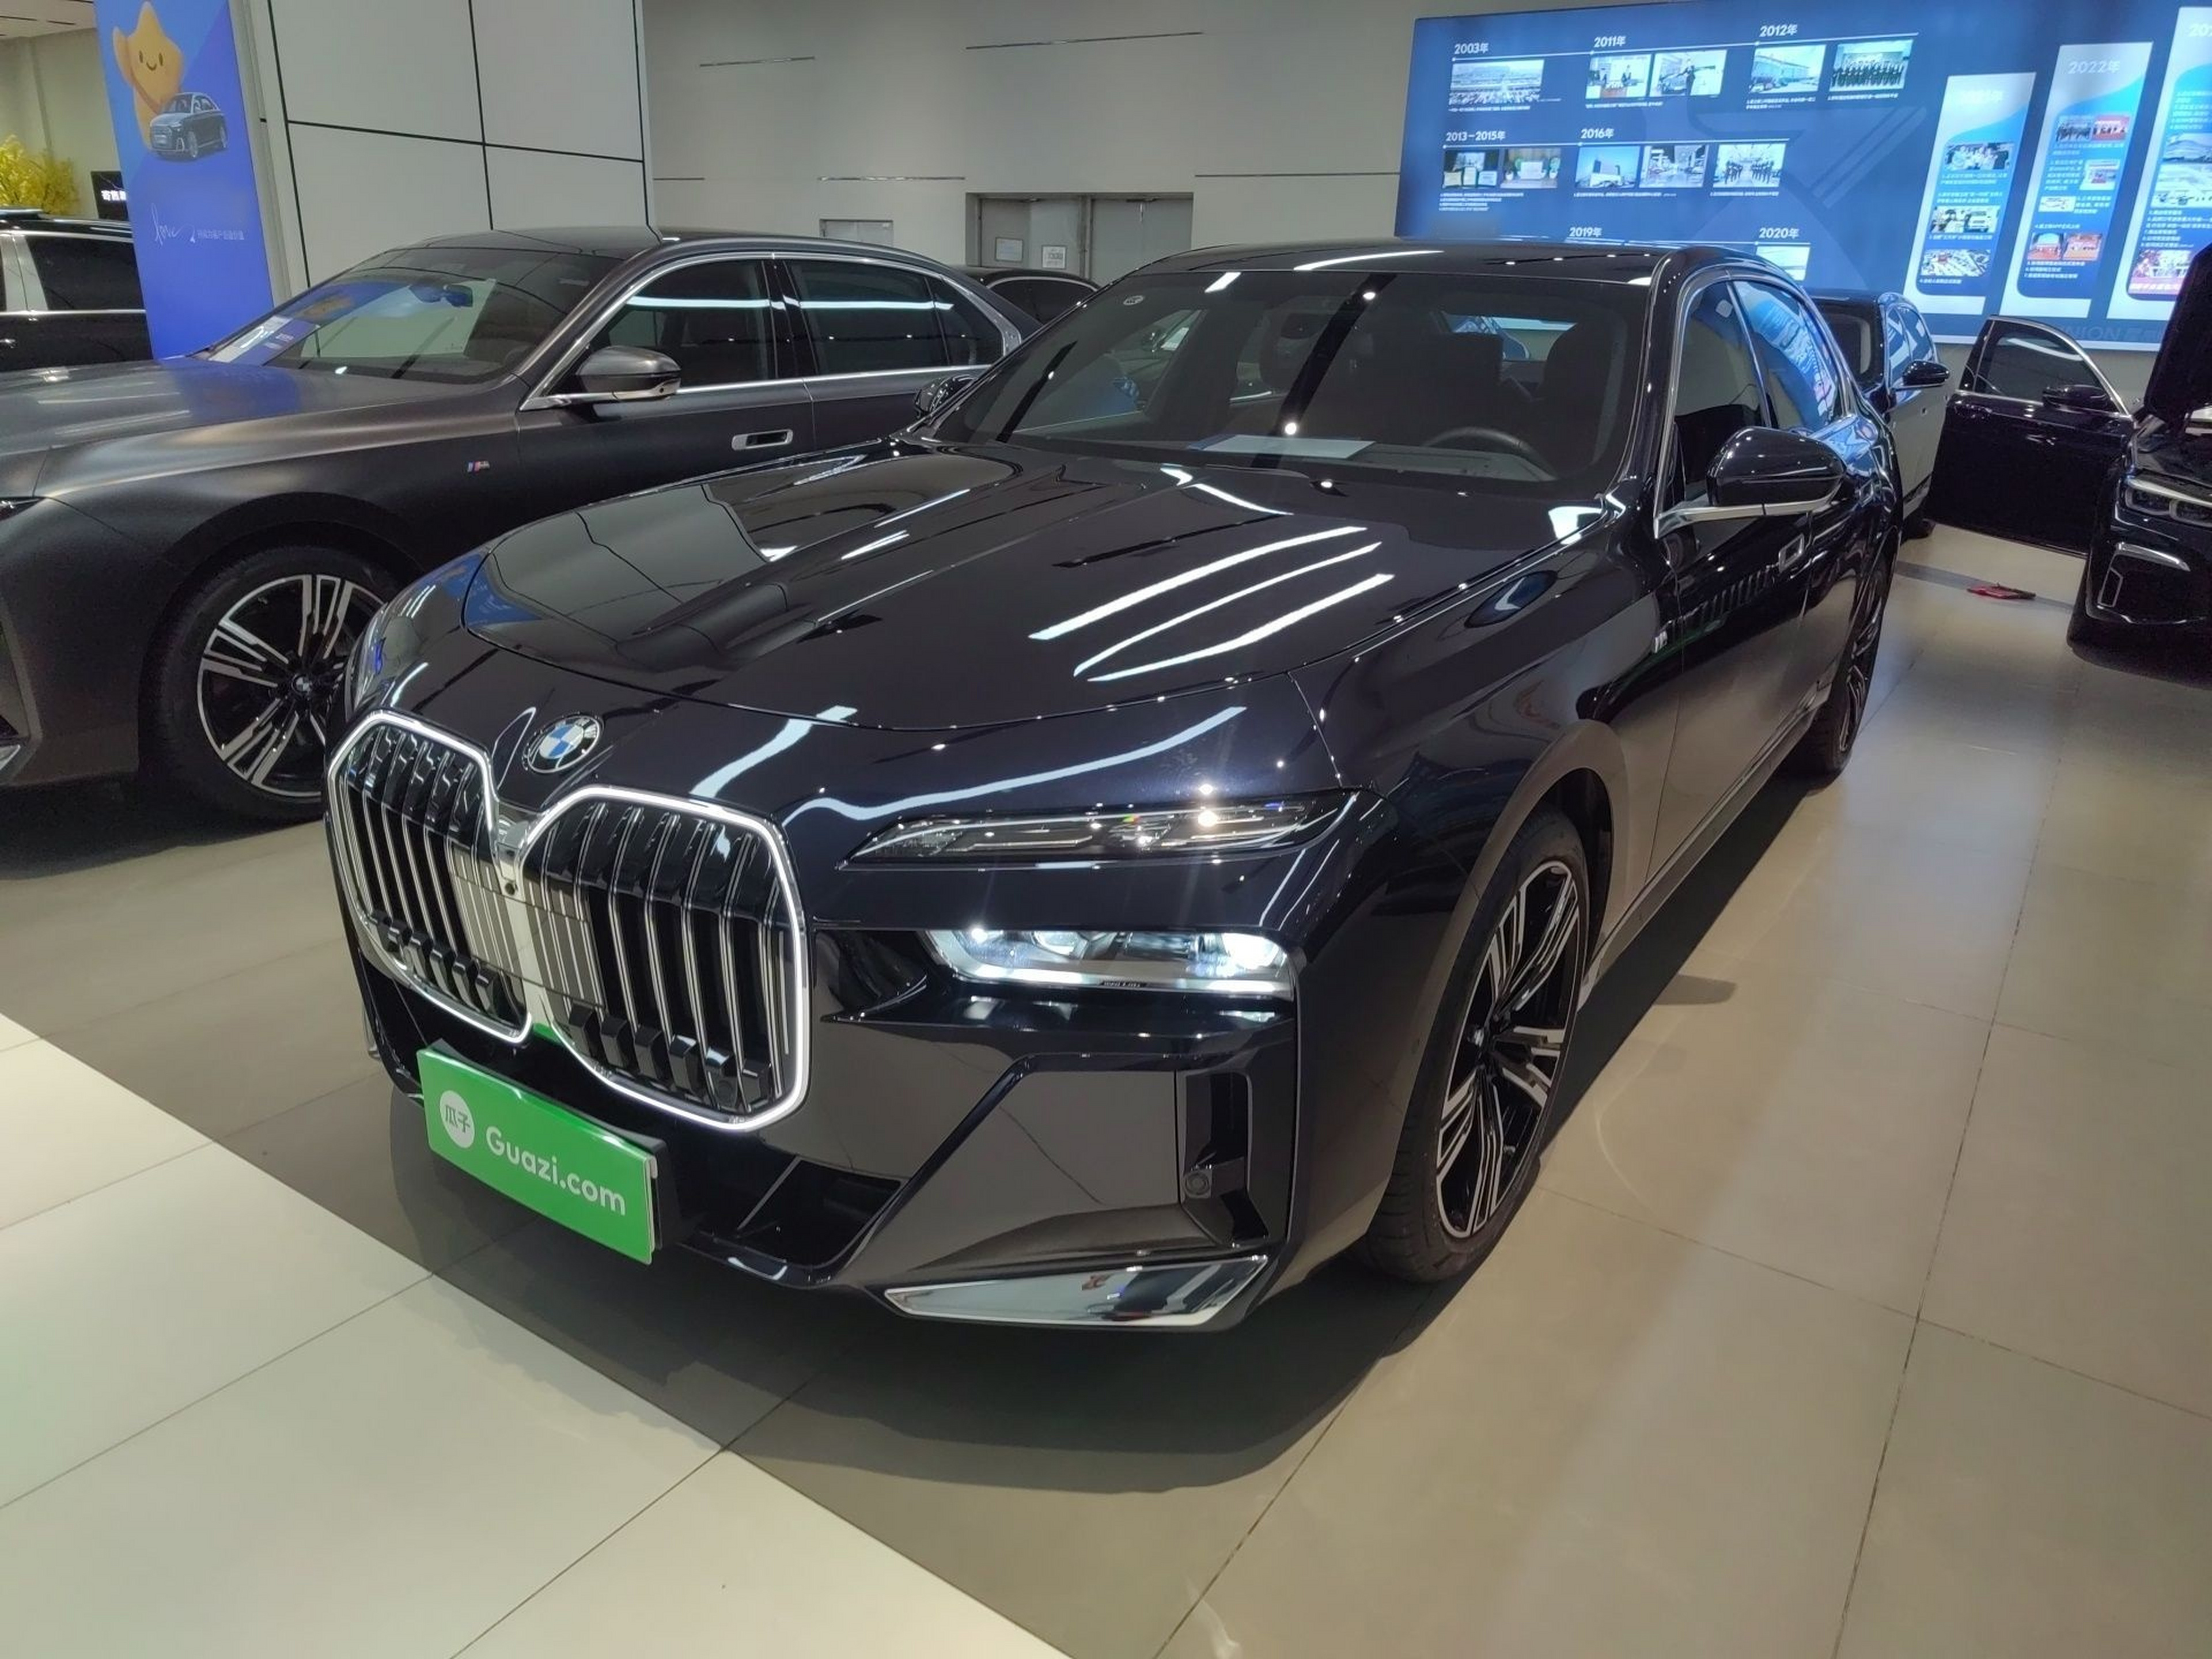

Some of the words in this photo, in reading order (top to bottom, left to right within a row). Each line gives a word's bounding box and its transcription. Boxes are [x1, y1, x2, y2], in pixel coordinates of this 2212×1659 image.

[1759, 24, 1798, 37] 2012年
[1594, 36, 1626, 47] 2011年
[1455, 43, 1488, 54] 2003年
[2069, 60, 2120, 74] 2022年
[1581, 128, 1614, 139] 2016年
[1569, 227, 1603, 237] 2019年
[1759, 228, 1800, 239] 2020年
[445, 1104, 470, 1134] 瓜子
[486, 1126, 626, 1216] Guazi.com
